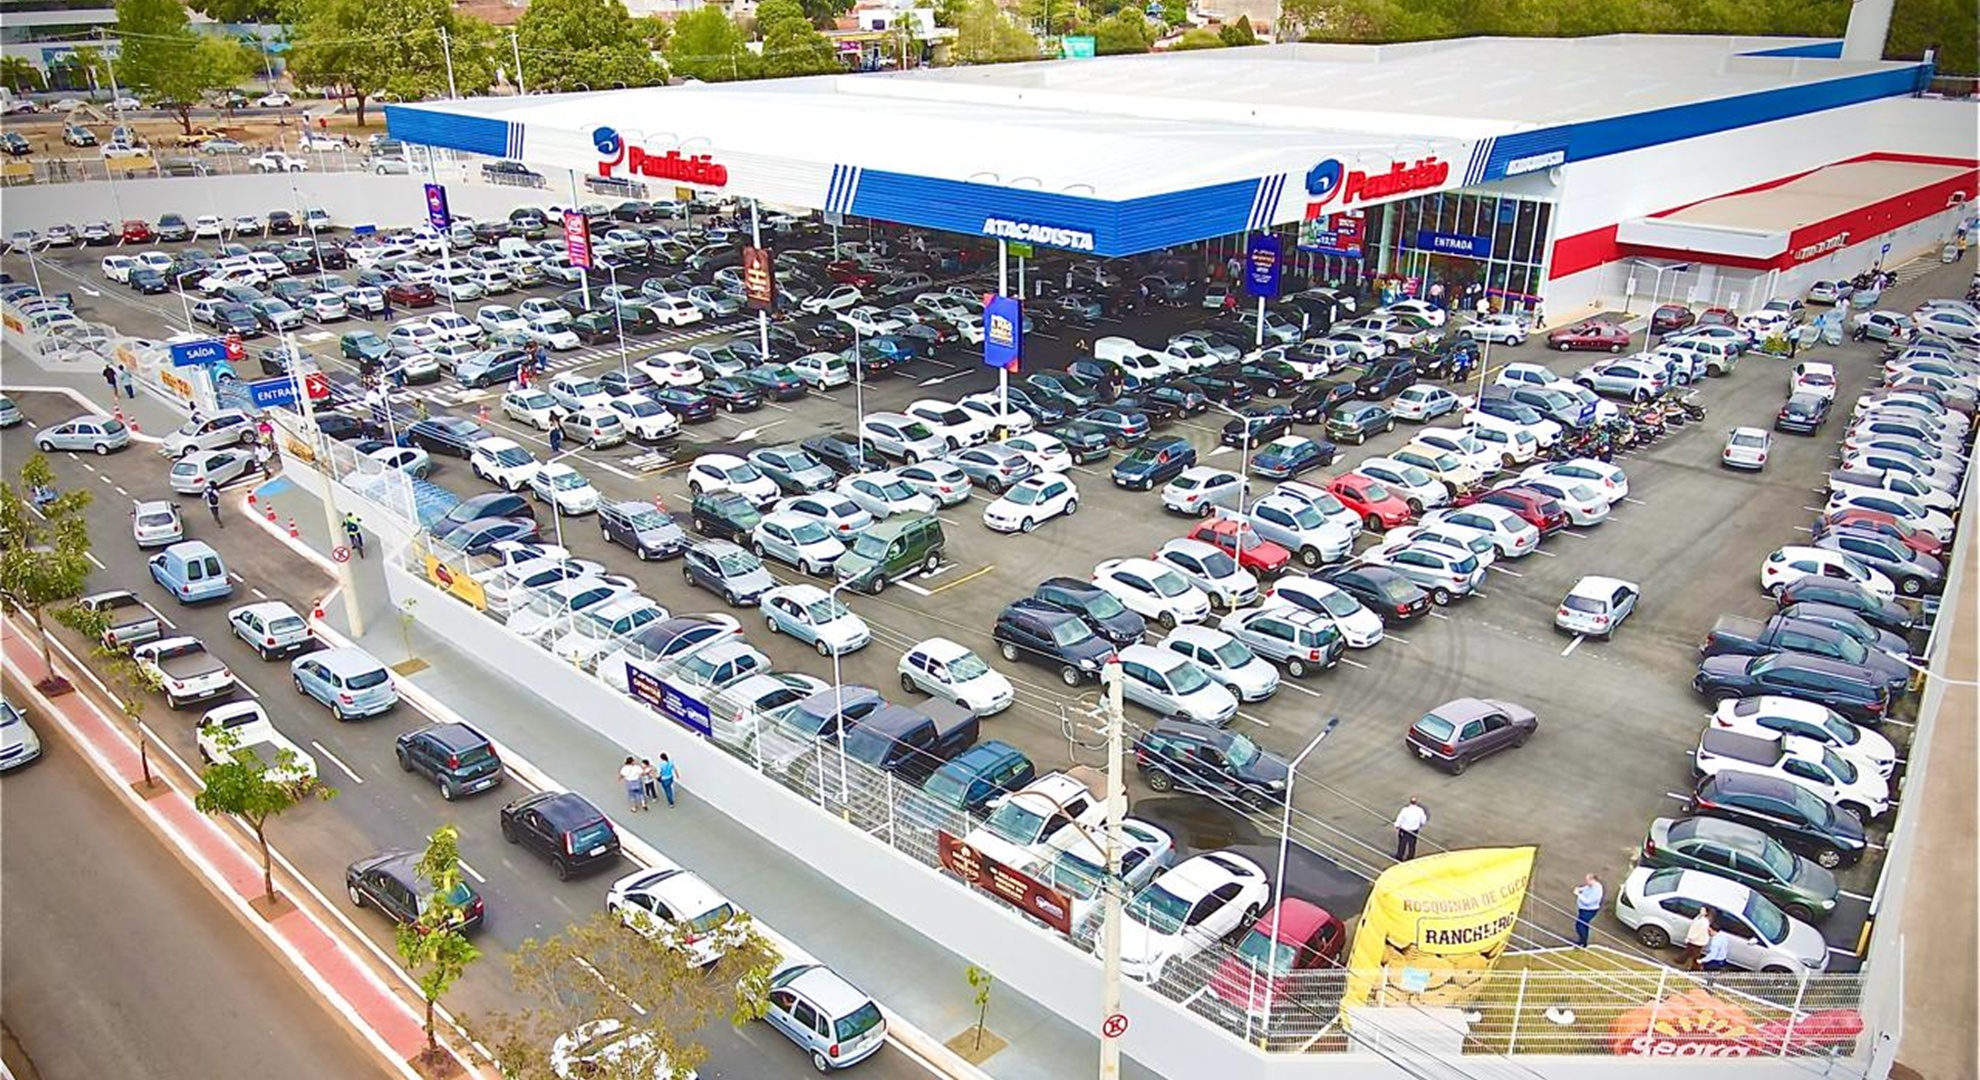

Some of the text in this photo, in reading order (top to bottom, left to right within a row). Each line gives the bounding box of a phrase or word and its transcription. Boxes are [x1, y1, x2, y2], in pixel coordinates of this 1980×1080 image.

[629, 146, 728, 187] Paulistão
[1343, 156, 1449, 204] Paulistão
[983, 218, 1094, 250] ATACADISTA
[1434, 236, 1473, 250] ENTRADA
[186, 347, 216, 360] SAÍDA
[258, 387, 298, 401] ENTRA
[1403, 875, 1527, 914] ROSQUINHA DE COCO
[1425, 912, 1515, 945] RANCHEIRO
